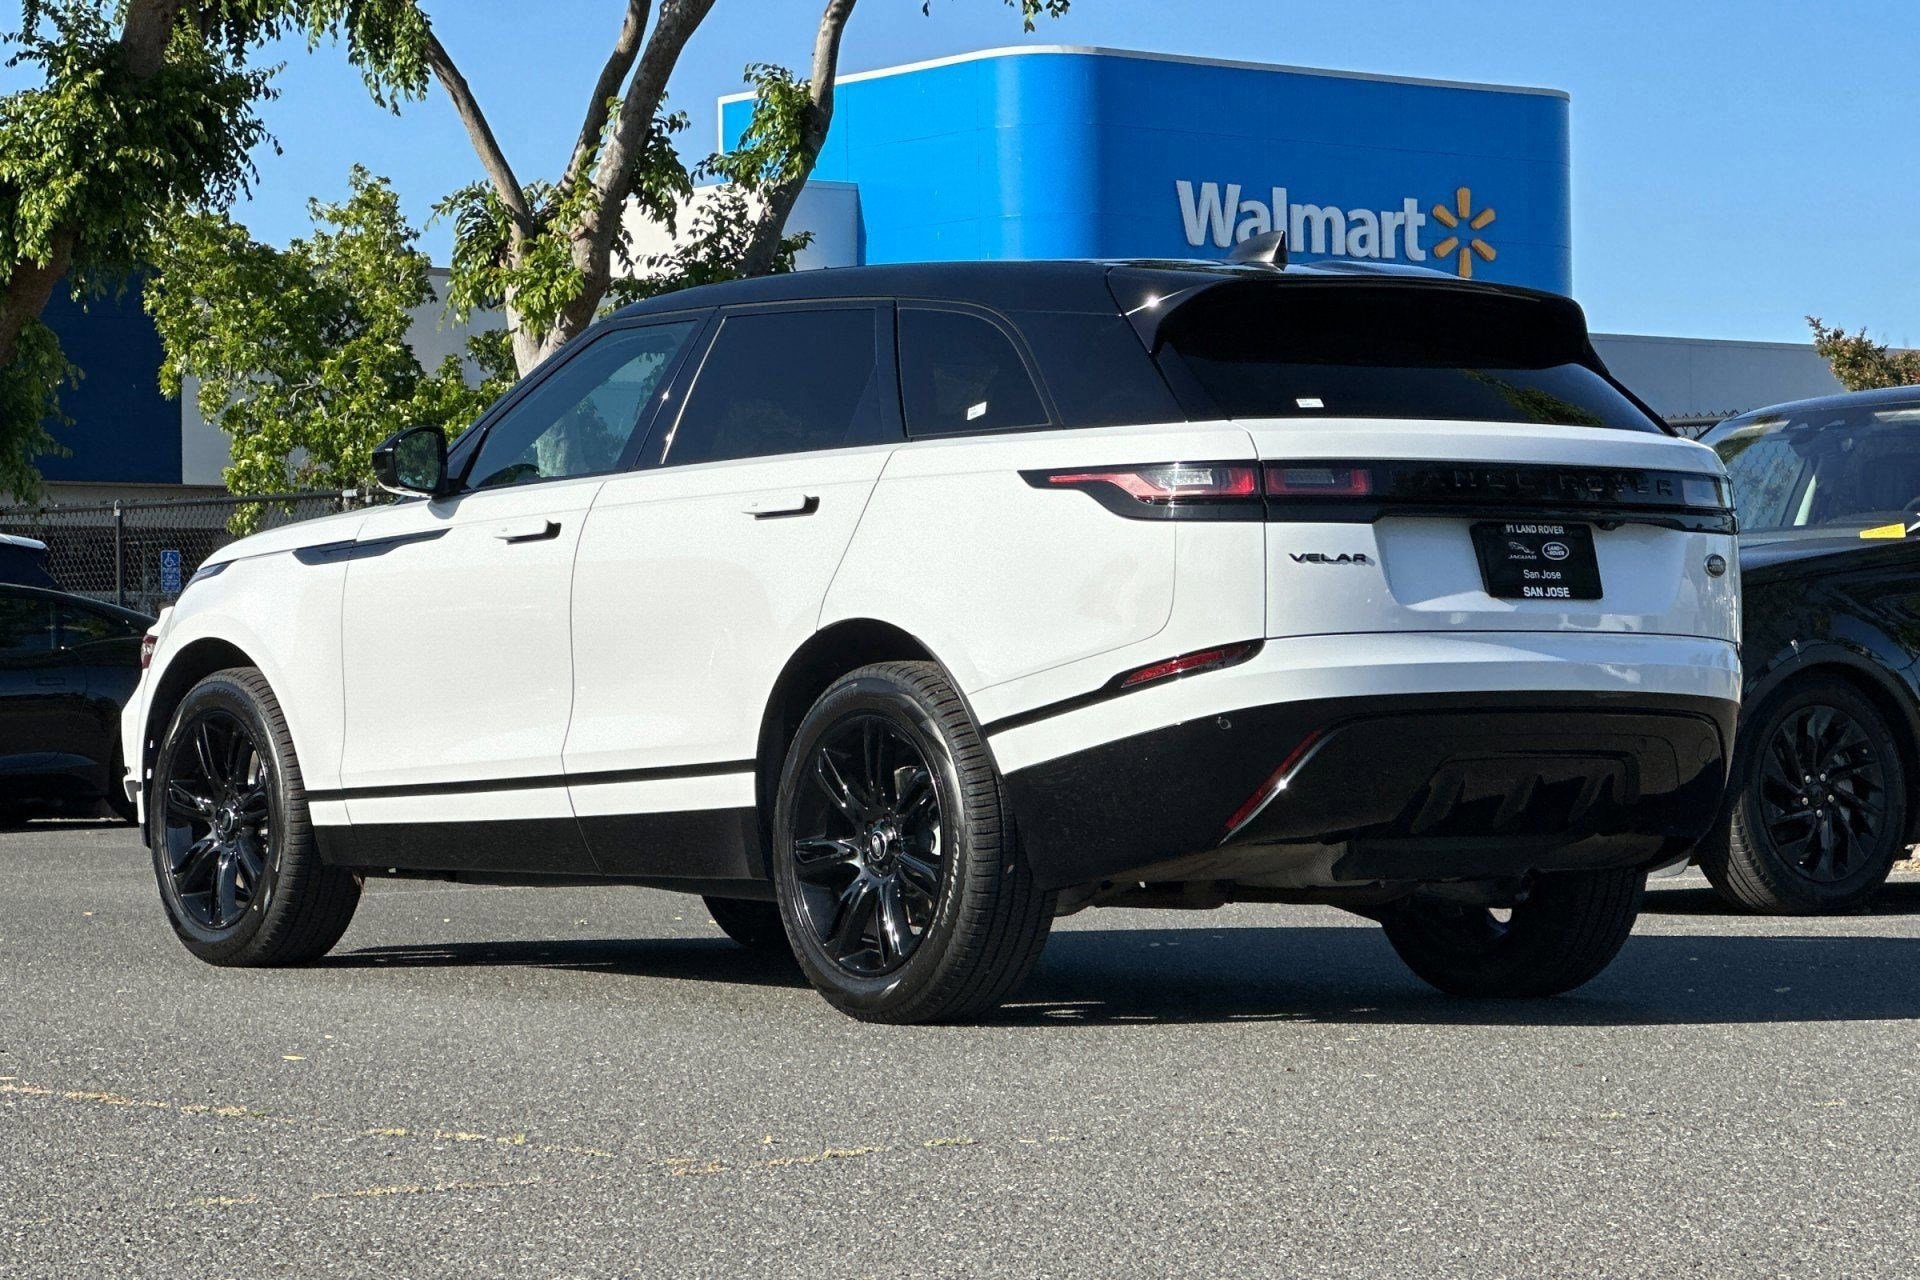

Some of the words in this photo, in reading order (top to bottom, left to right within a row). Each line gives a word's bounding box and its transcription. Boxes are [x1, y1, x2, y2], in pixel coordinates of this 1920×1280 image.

[1176, 180, 1426, 261] Walmart
[1515, 524, 1537, 534] LAND
[1537, 525, 1564, 534] ROVER
[1288, 552, 1369, 564] VELAR
[1523, 569, 1540, 579] San
[1541, 570, 1561, 579] Jose
[1523, 586, 1544, 597] SAN
[1544, 587, 1571, 598] JOSE
